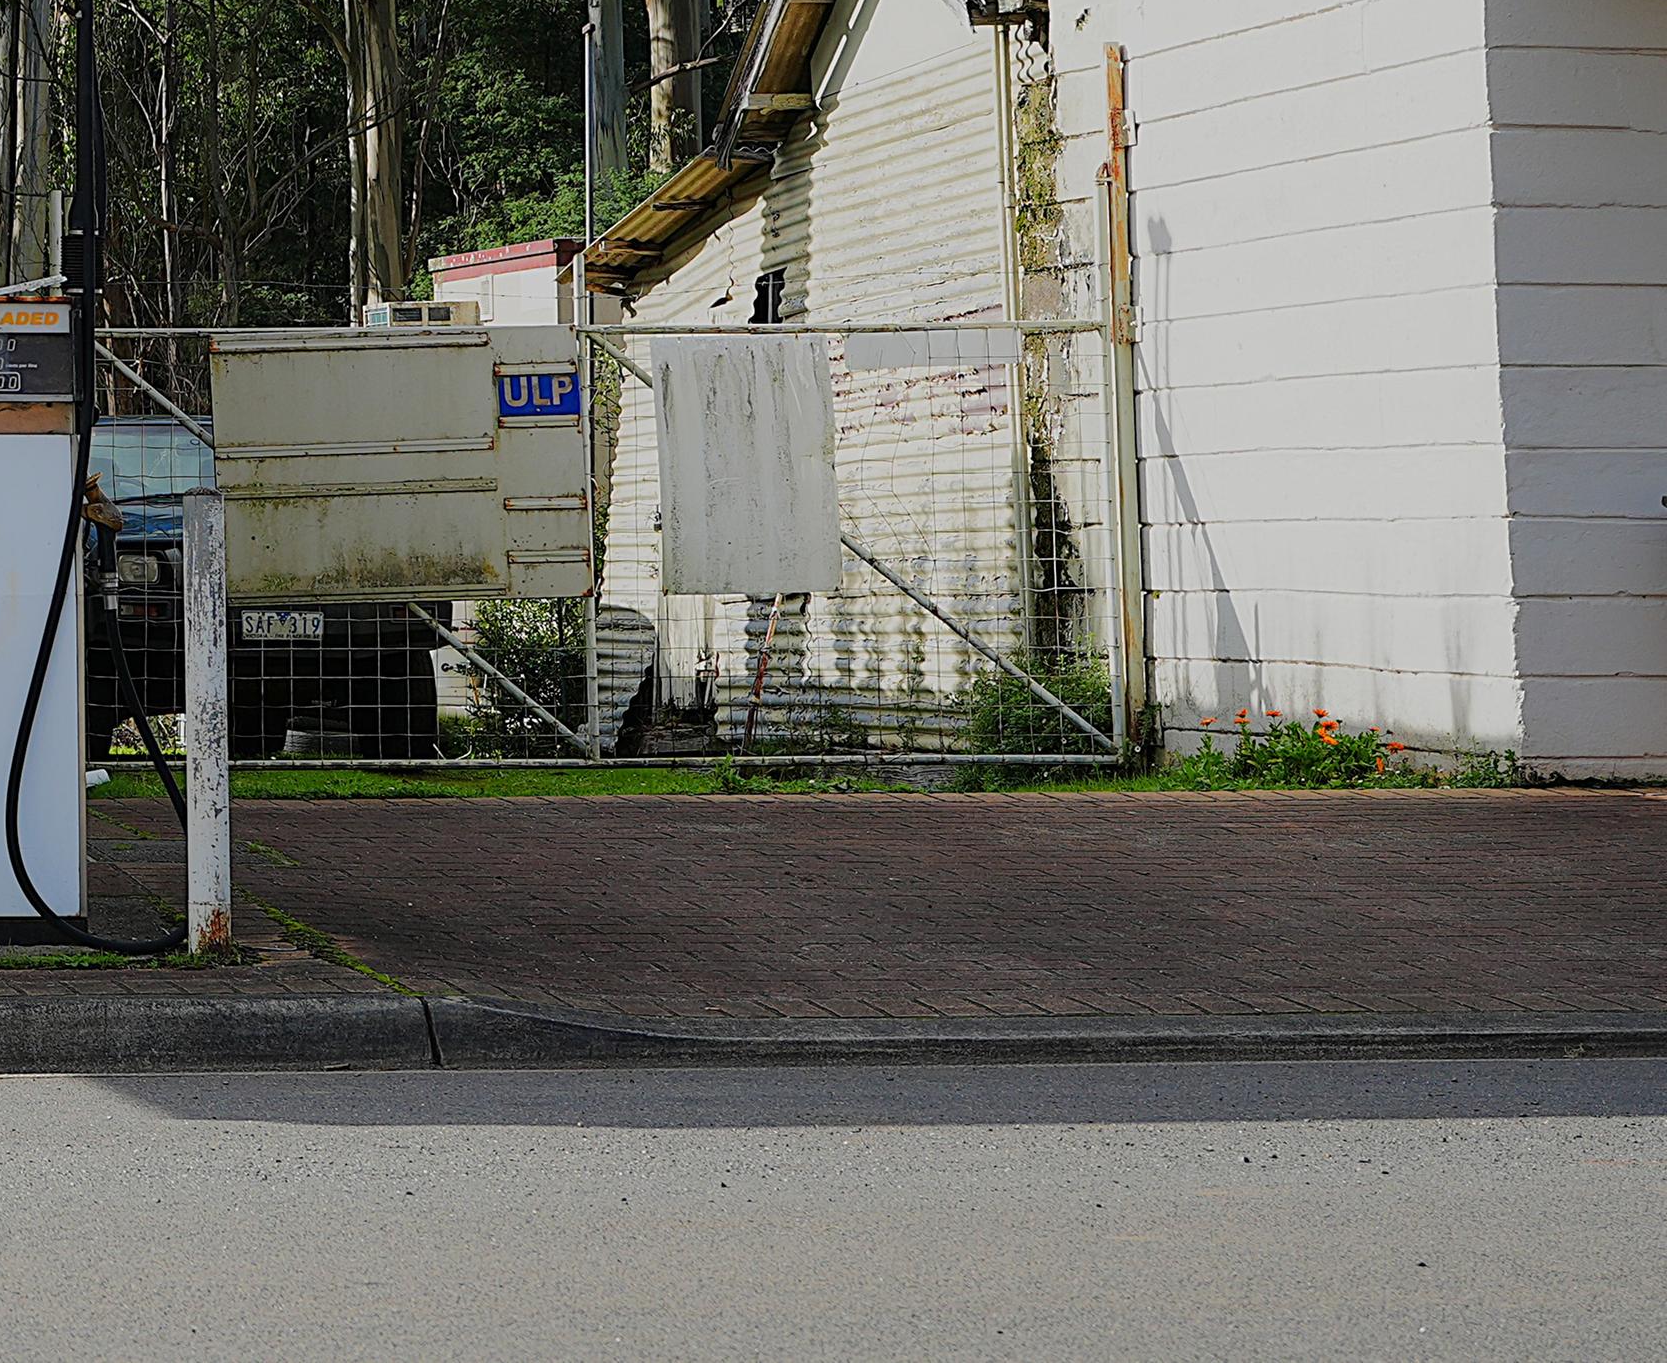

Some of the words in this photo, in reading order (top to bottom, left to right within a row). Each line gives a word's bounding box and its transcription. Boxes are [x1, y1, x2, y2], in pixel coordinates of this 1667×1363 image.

[502, 375, 573, 408] ULP
[245, 616, 275, 633] SAF
[289, 616, 321, 634] 319
